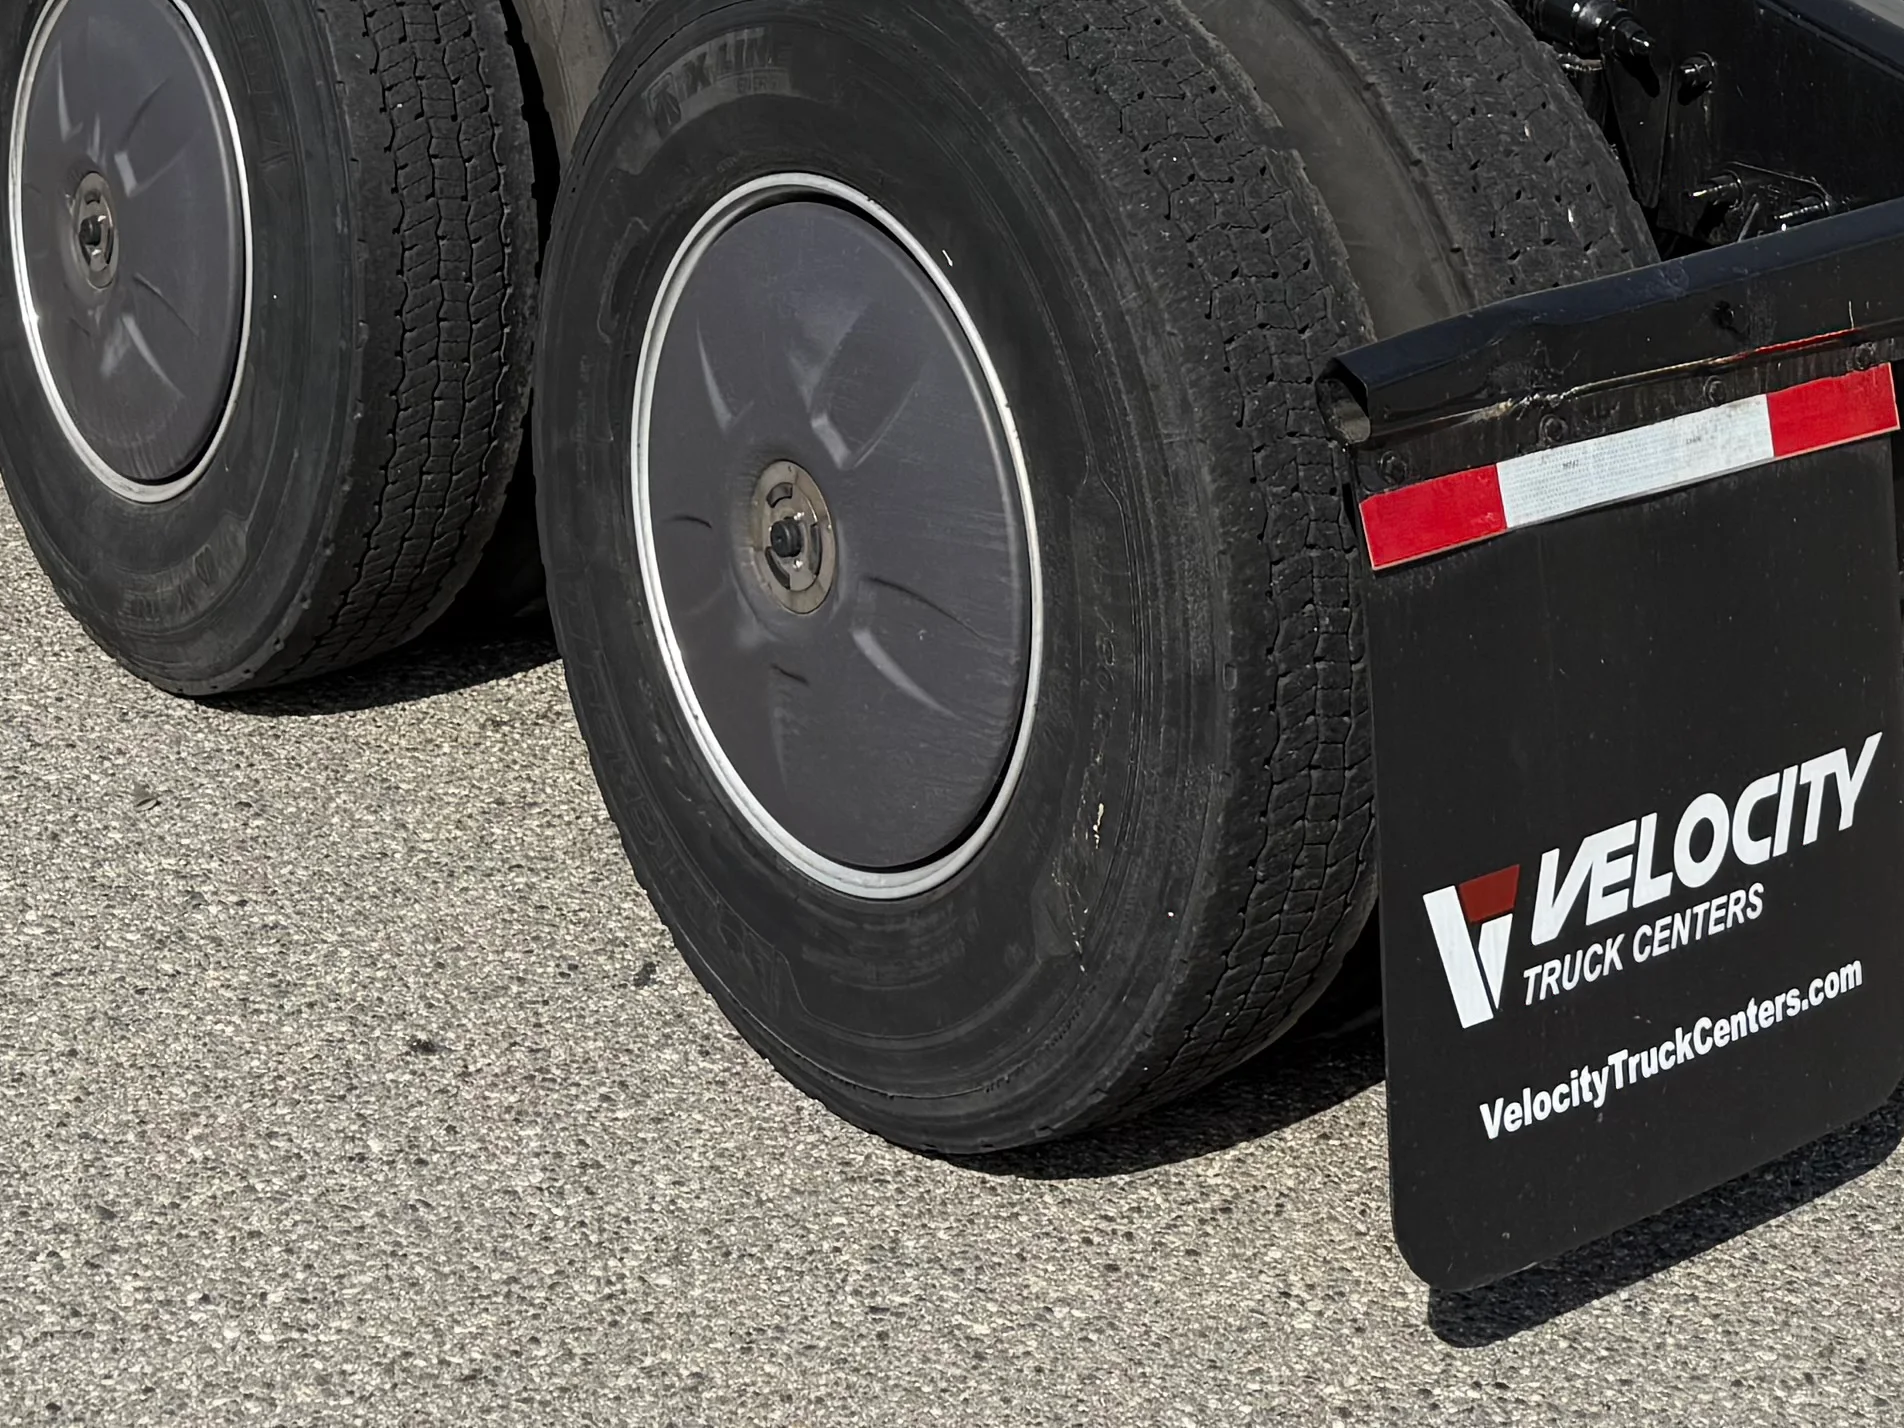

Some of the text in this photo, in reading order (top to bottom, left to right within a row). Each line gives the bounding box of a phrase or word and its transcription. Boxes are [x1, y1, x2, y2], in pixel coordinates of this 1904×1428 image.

[1533, 731, 1883, 946] VELOCITY
[1523, 882, 1765, 1006] TRUCK CENTERS
[1479, 960, 1863, 1140] VelocityTruckCenters.com
